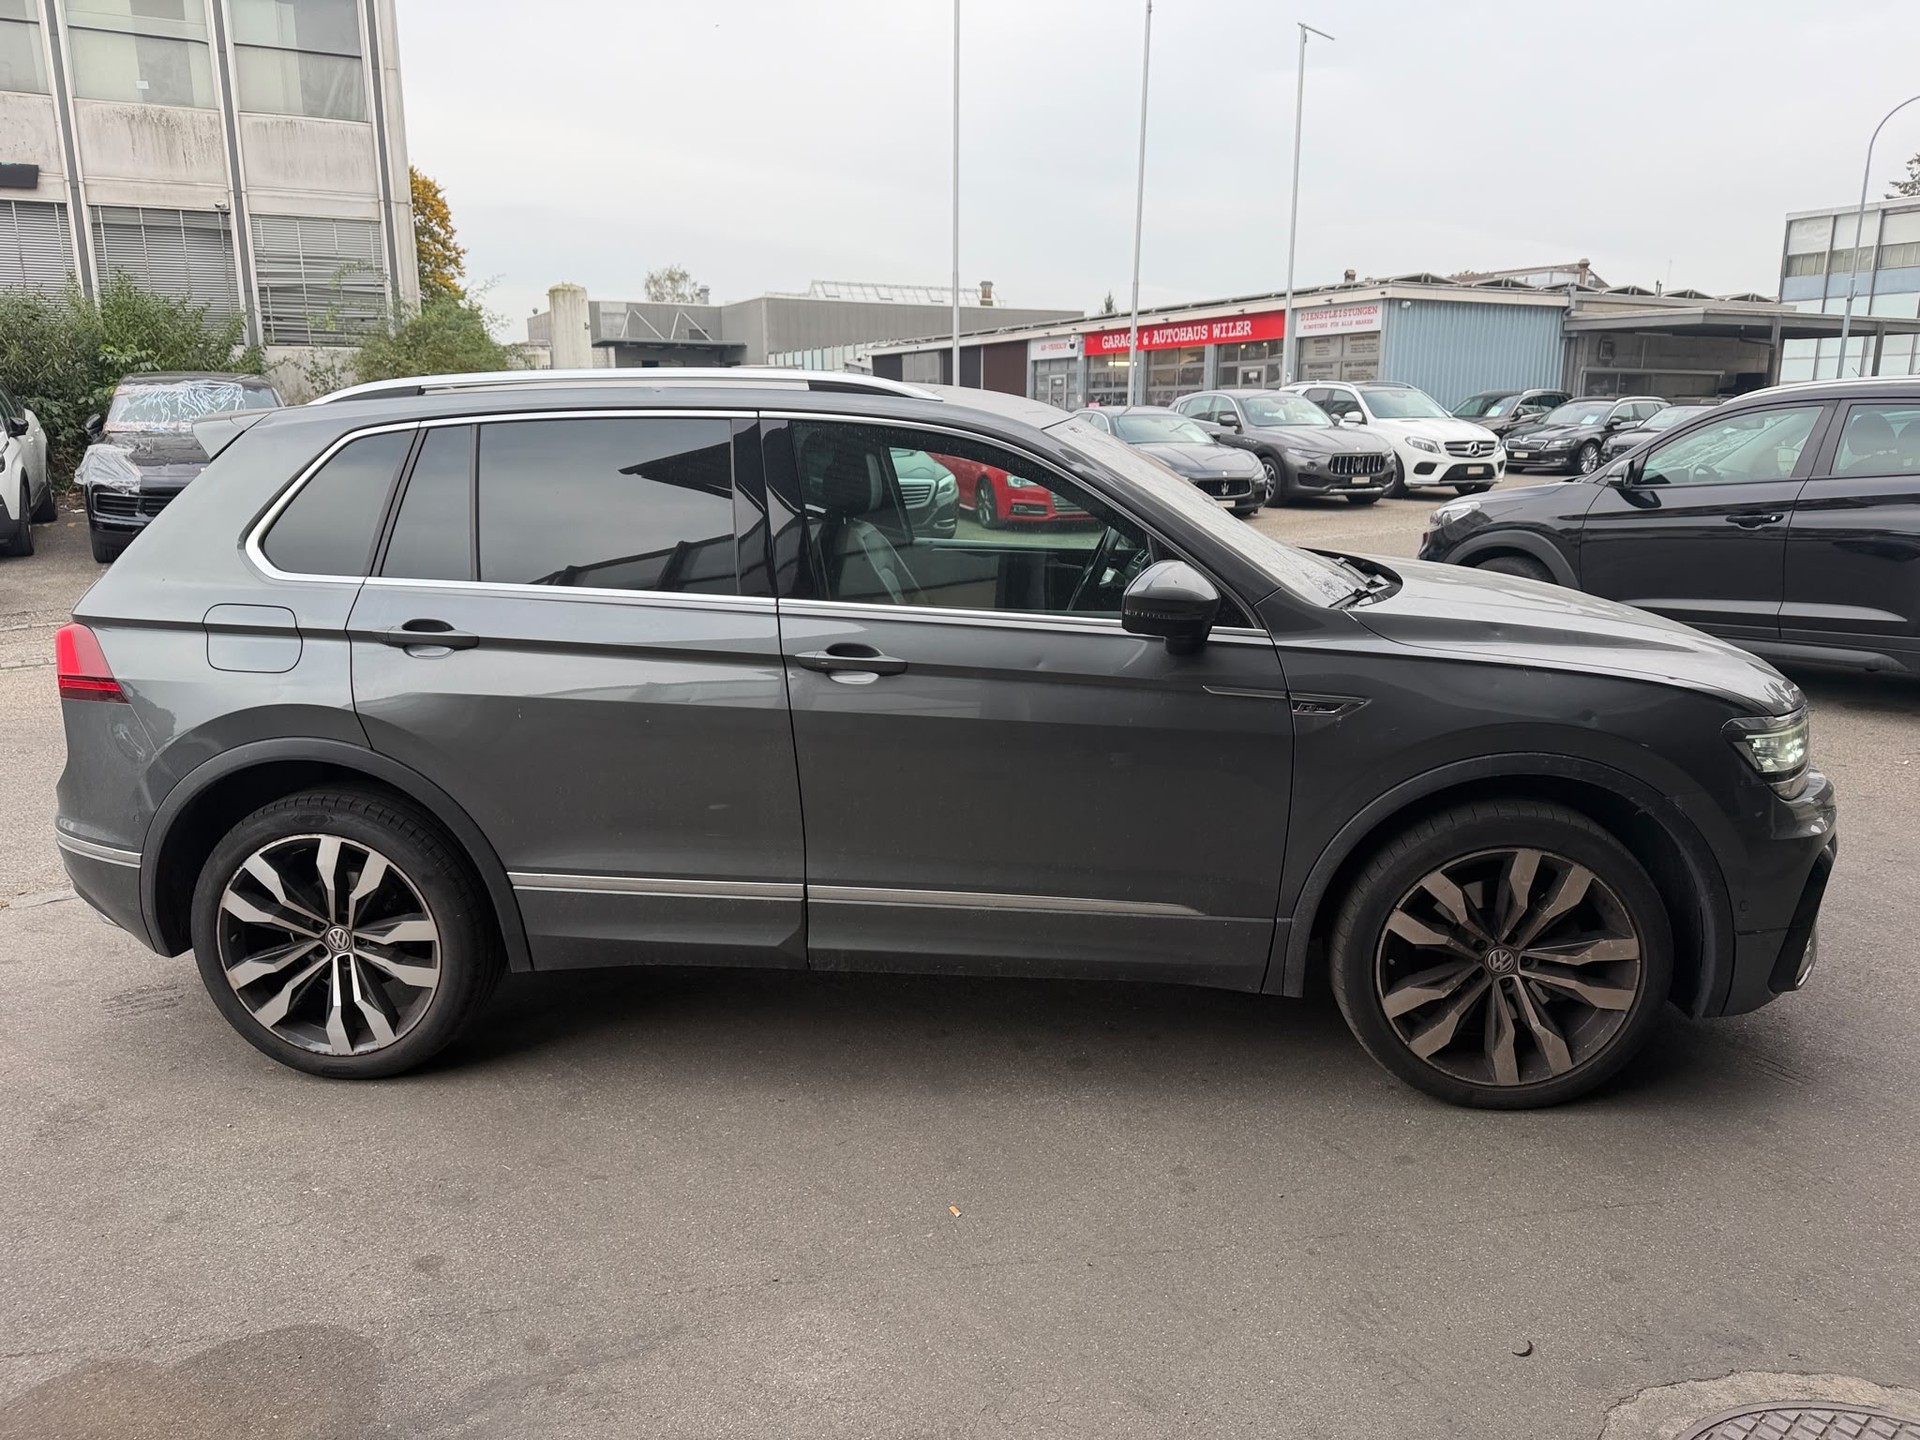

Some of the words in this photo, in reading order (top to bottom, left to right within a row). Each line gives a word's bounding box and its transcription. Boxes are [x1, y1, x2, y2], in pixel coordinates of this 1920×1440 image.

[1300, 305, 1378, 321] DIENSTLEISTUNGEN
[1143, 332, 1149, 345] &
[1152, 325, 1208, 345] AUTOHAUS
[1212, 320, 1252, 337] WILER
